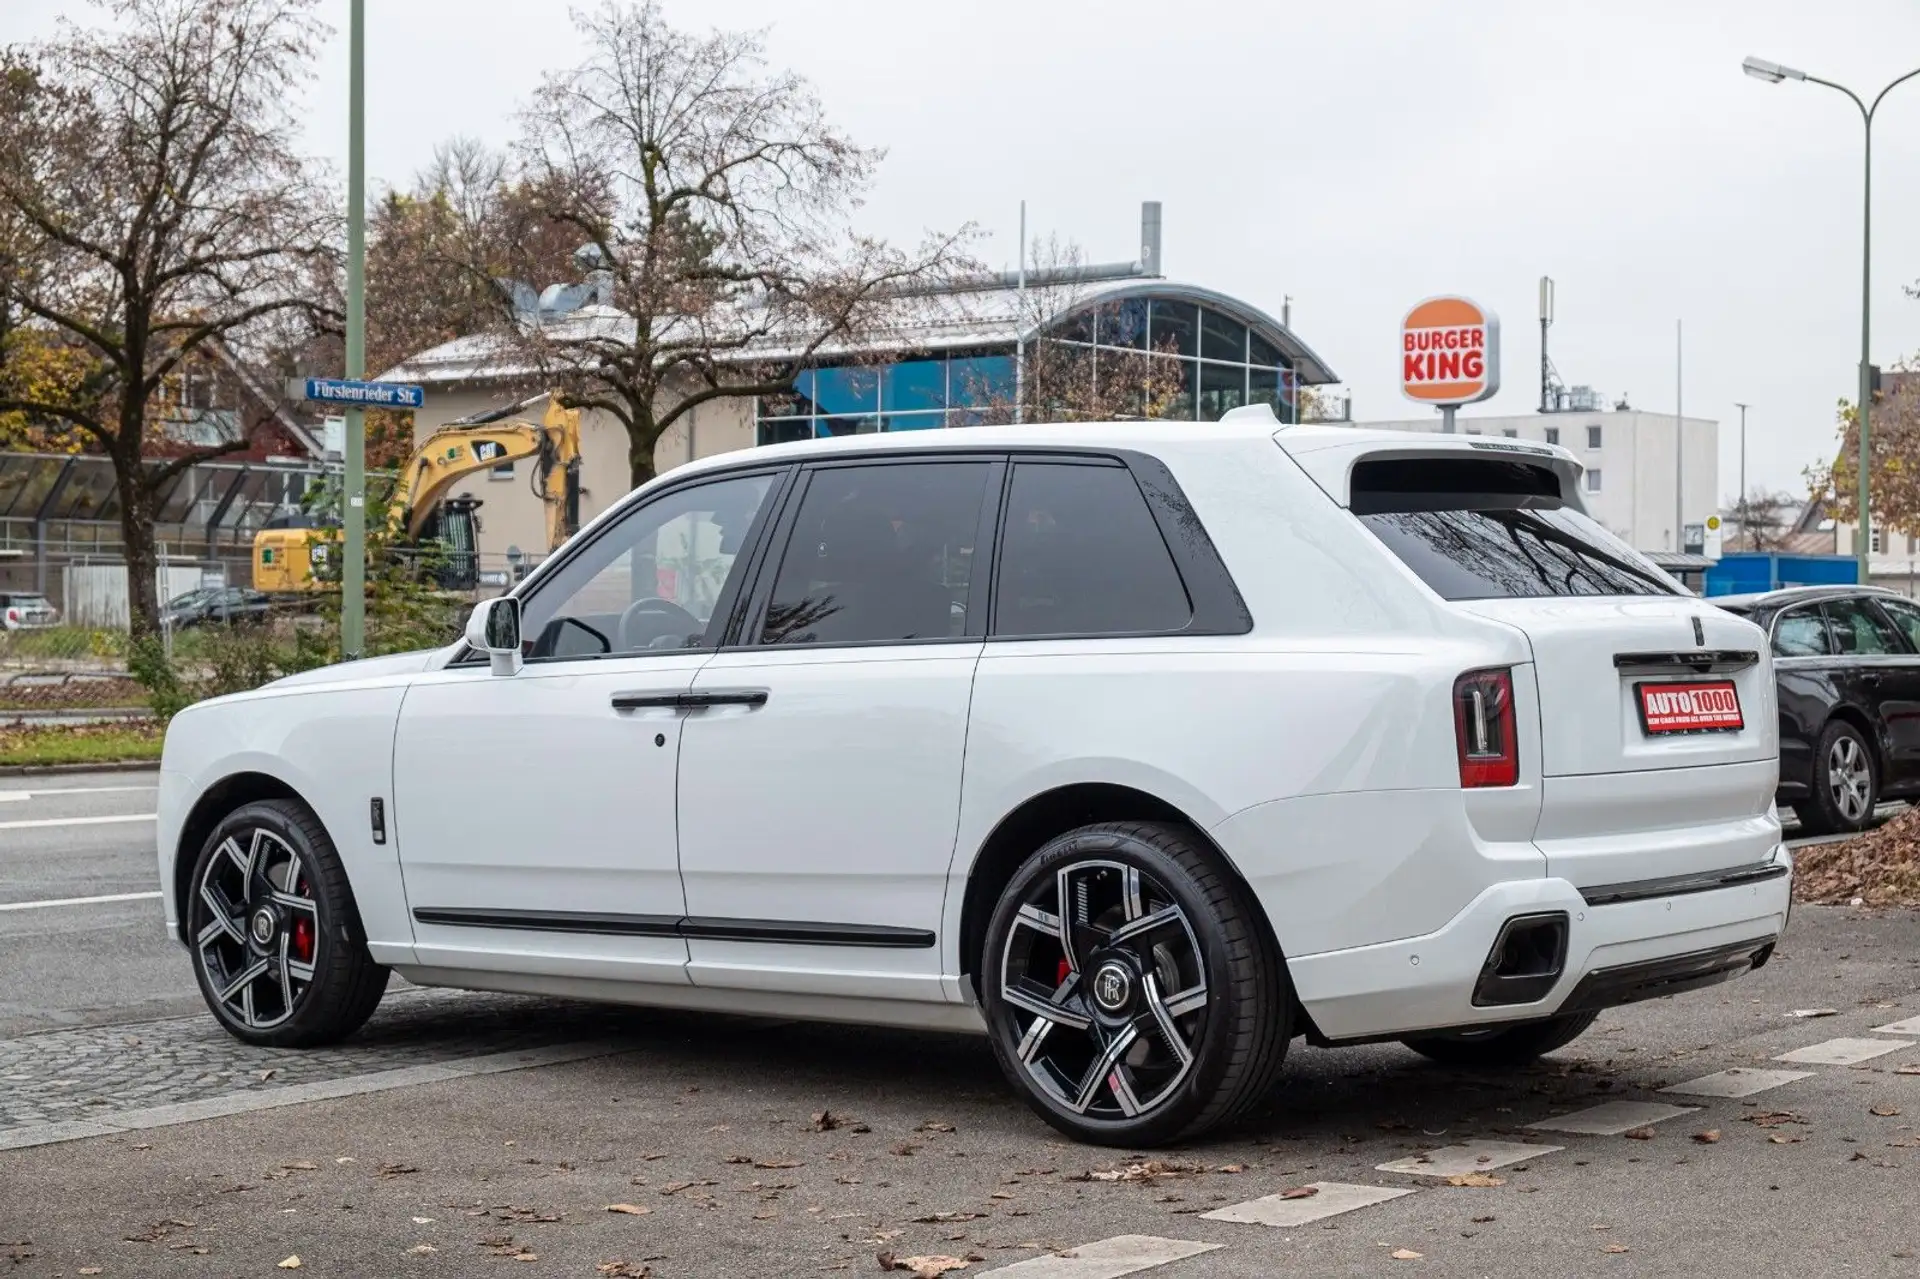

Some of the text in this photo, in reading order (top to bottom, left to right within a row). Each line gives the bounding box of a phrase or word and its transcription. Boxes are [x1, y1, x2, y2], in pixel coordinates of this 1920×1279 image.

[1404, 328, 1484, 351] BURGER
[1404, 350, 1484, 381] KING
[313, 381, 416, 403] Fürstenrieder Str.
[1646, 691, 1735, 715] AUTO1000
